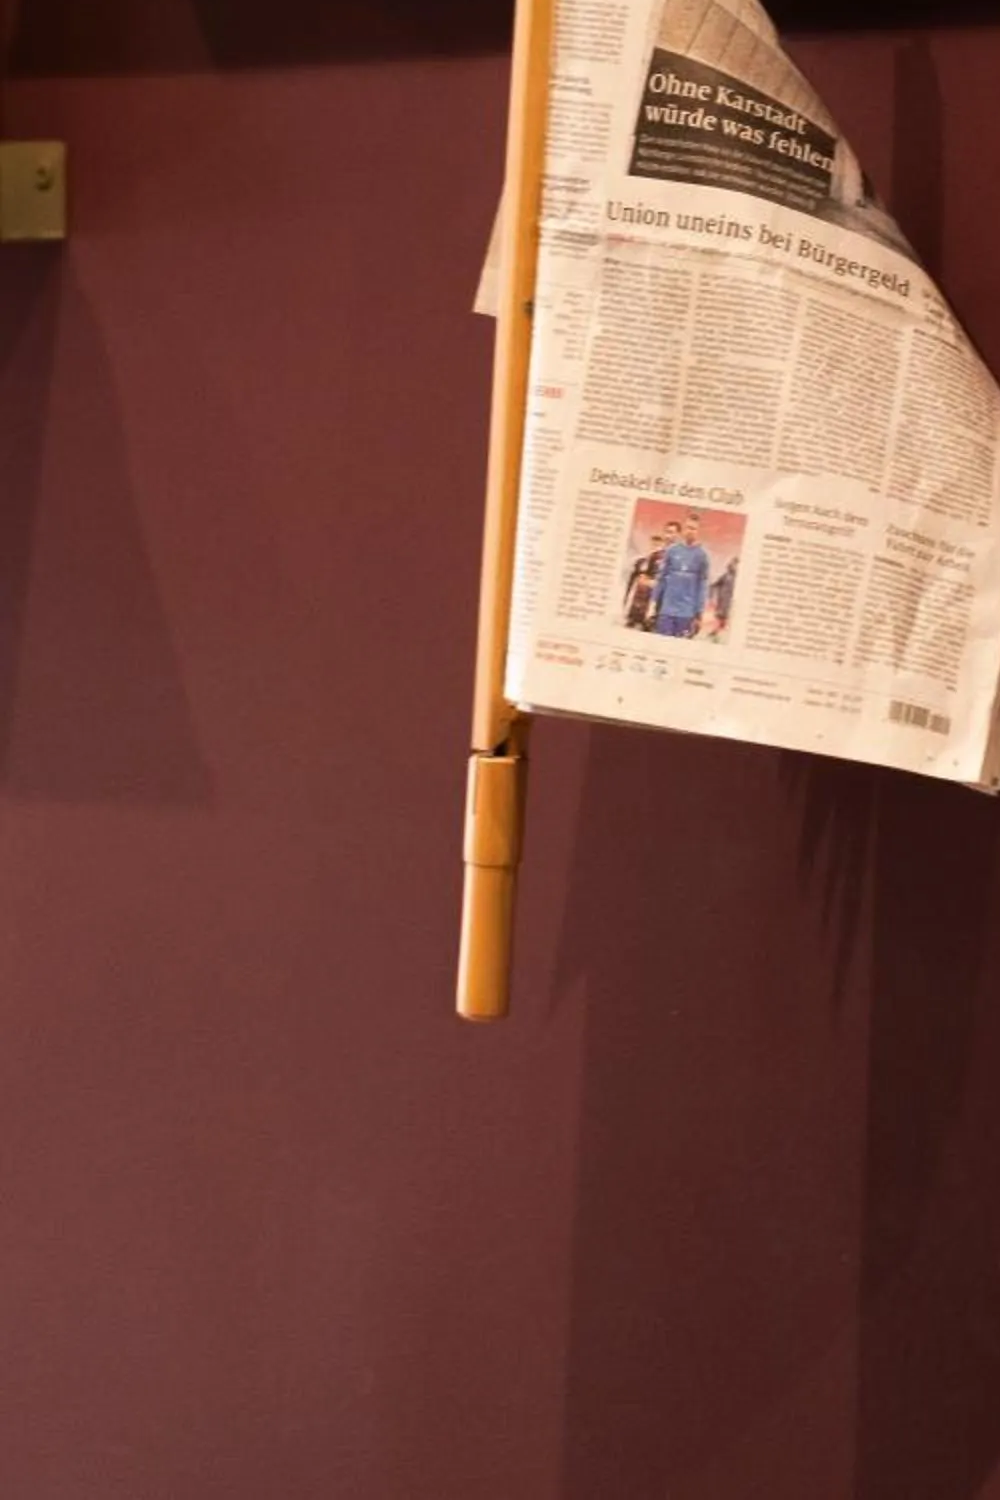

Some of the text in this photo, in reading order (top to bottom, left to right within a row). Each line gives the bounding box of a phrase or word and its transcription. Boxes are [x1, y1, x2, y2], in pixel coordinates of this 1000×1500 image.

[645, 103, 717, 132] würde
[721, 118, 764, 146] was
[768, 130, 834, 170] fehlen
[650, 73, 807, 134] Ohne Karstadt
[606, 200, 670, 227] Union
[676, 213, 753, 240] uneins
[758, 223, 792, 252] bei
[799, 238, 910, 297] Bürgergeld
